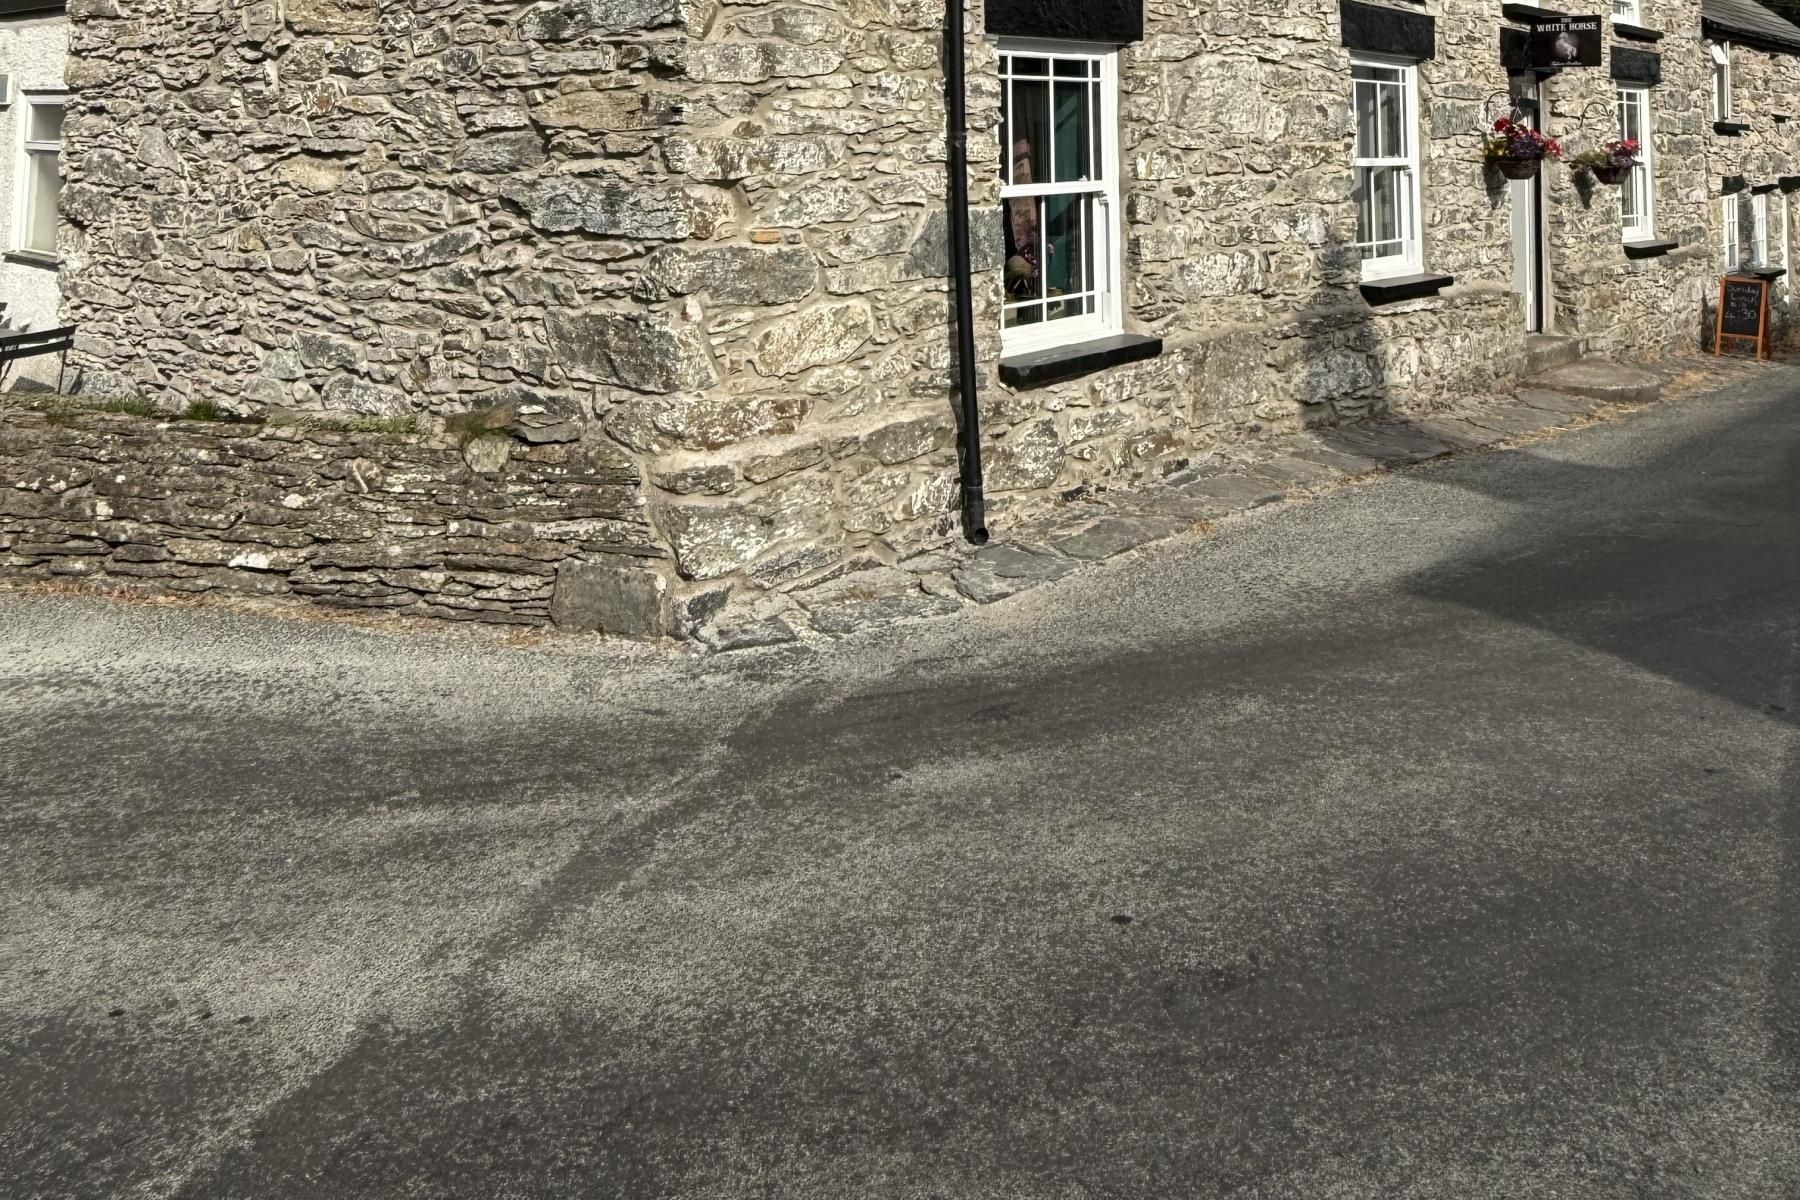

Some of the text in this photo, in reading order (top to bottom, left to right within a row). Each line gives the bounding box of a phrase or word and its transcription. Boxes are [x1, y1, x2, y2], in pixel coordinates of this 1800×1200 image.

[1536, 22, 1597, 32] WHITE HORSE
[1728, 286, 1759, 297] Sunday
